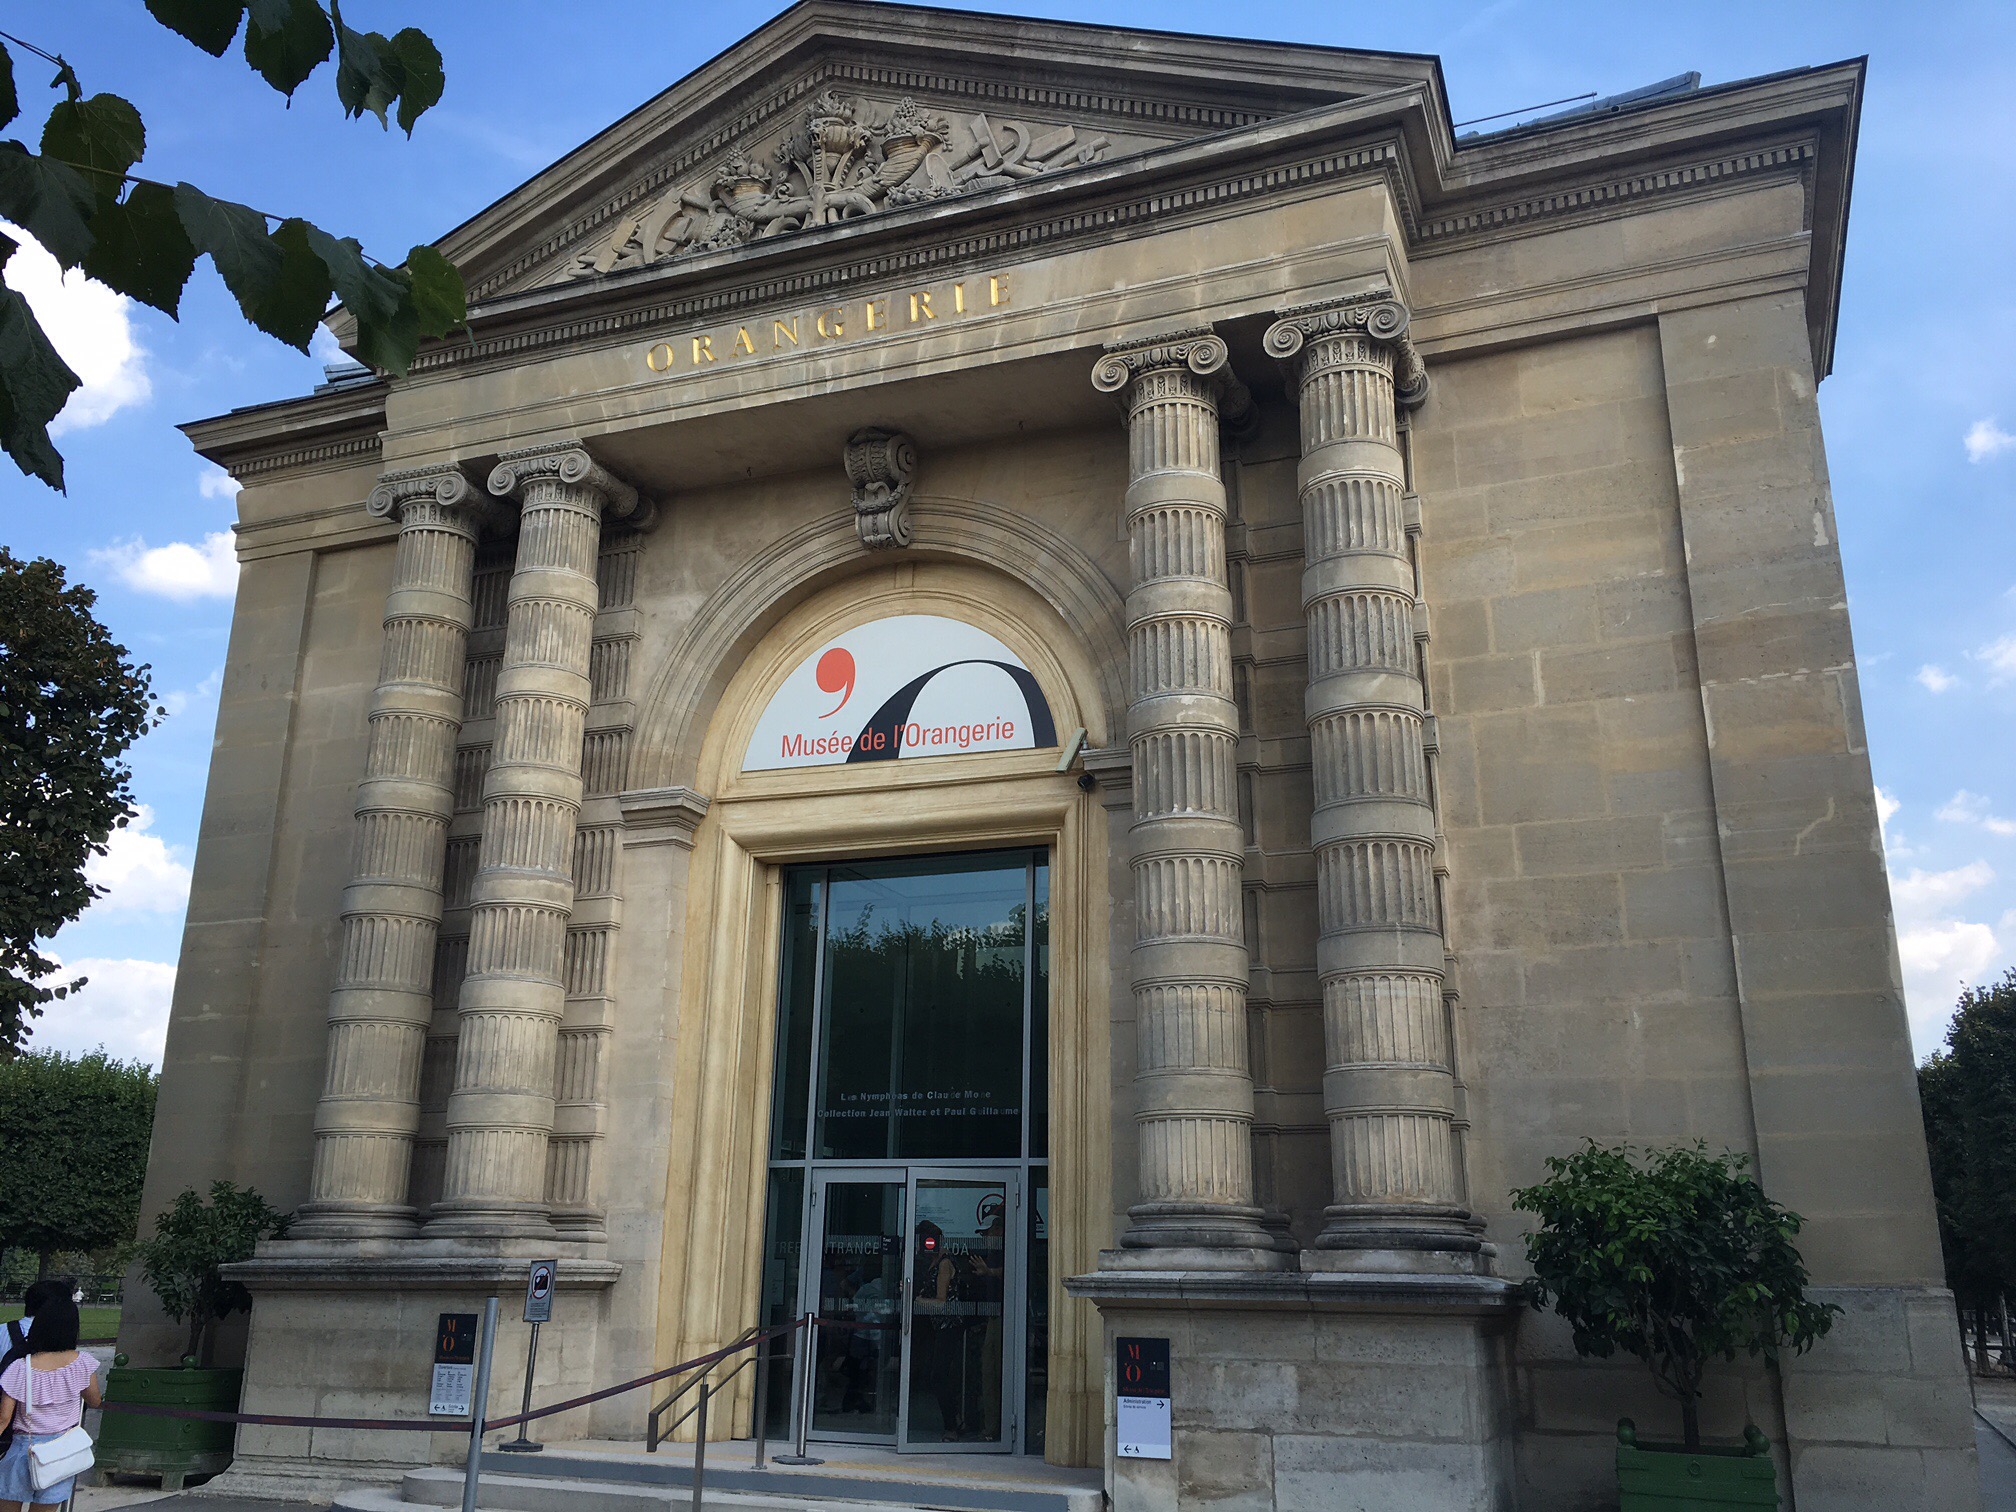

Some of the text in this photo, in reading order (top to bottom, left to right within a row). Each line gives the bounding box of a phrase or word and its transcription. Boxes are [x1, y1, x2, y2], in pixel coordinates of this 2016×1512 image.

[646, 272, 1011, 374] ORANGERIE
[781, 716, 1015, 758] Musée de l'Orangerie
[912, 1091, 924, 1100] de
[817, 1109, 866, 1118] Collection
[869, 1109, 891, 1117] Jean
[895, 1108, 927, 1117] Walter
[930, 1108, 941, 1116] et
[944, 1107, 966, 1116] Paul
